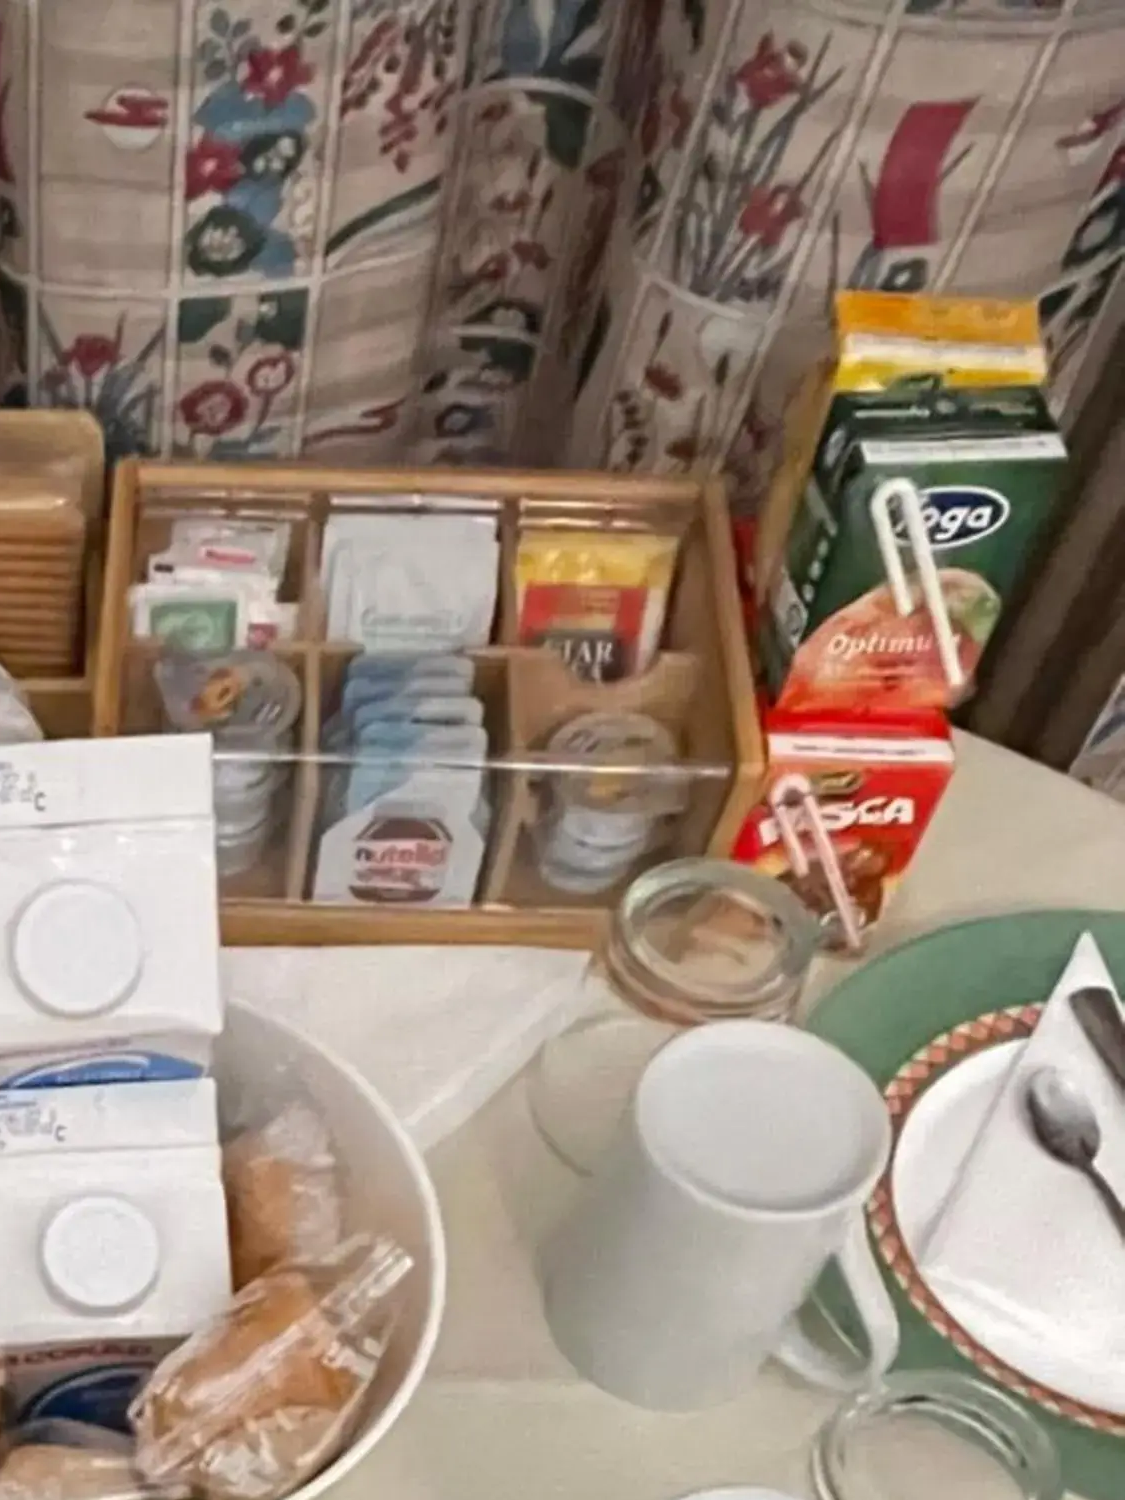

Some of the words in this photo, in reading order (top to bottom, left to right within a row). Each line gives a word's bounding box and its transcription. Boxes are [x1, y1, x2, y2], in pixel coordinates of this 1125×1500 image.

[893, 495, 993, 541] oga
[545, 638, 613, 664] TAR
[827, 632, 962, 661] Optimu
